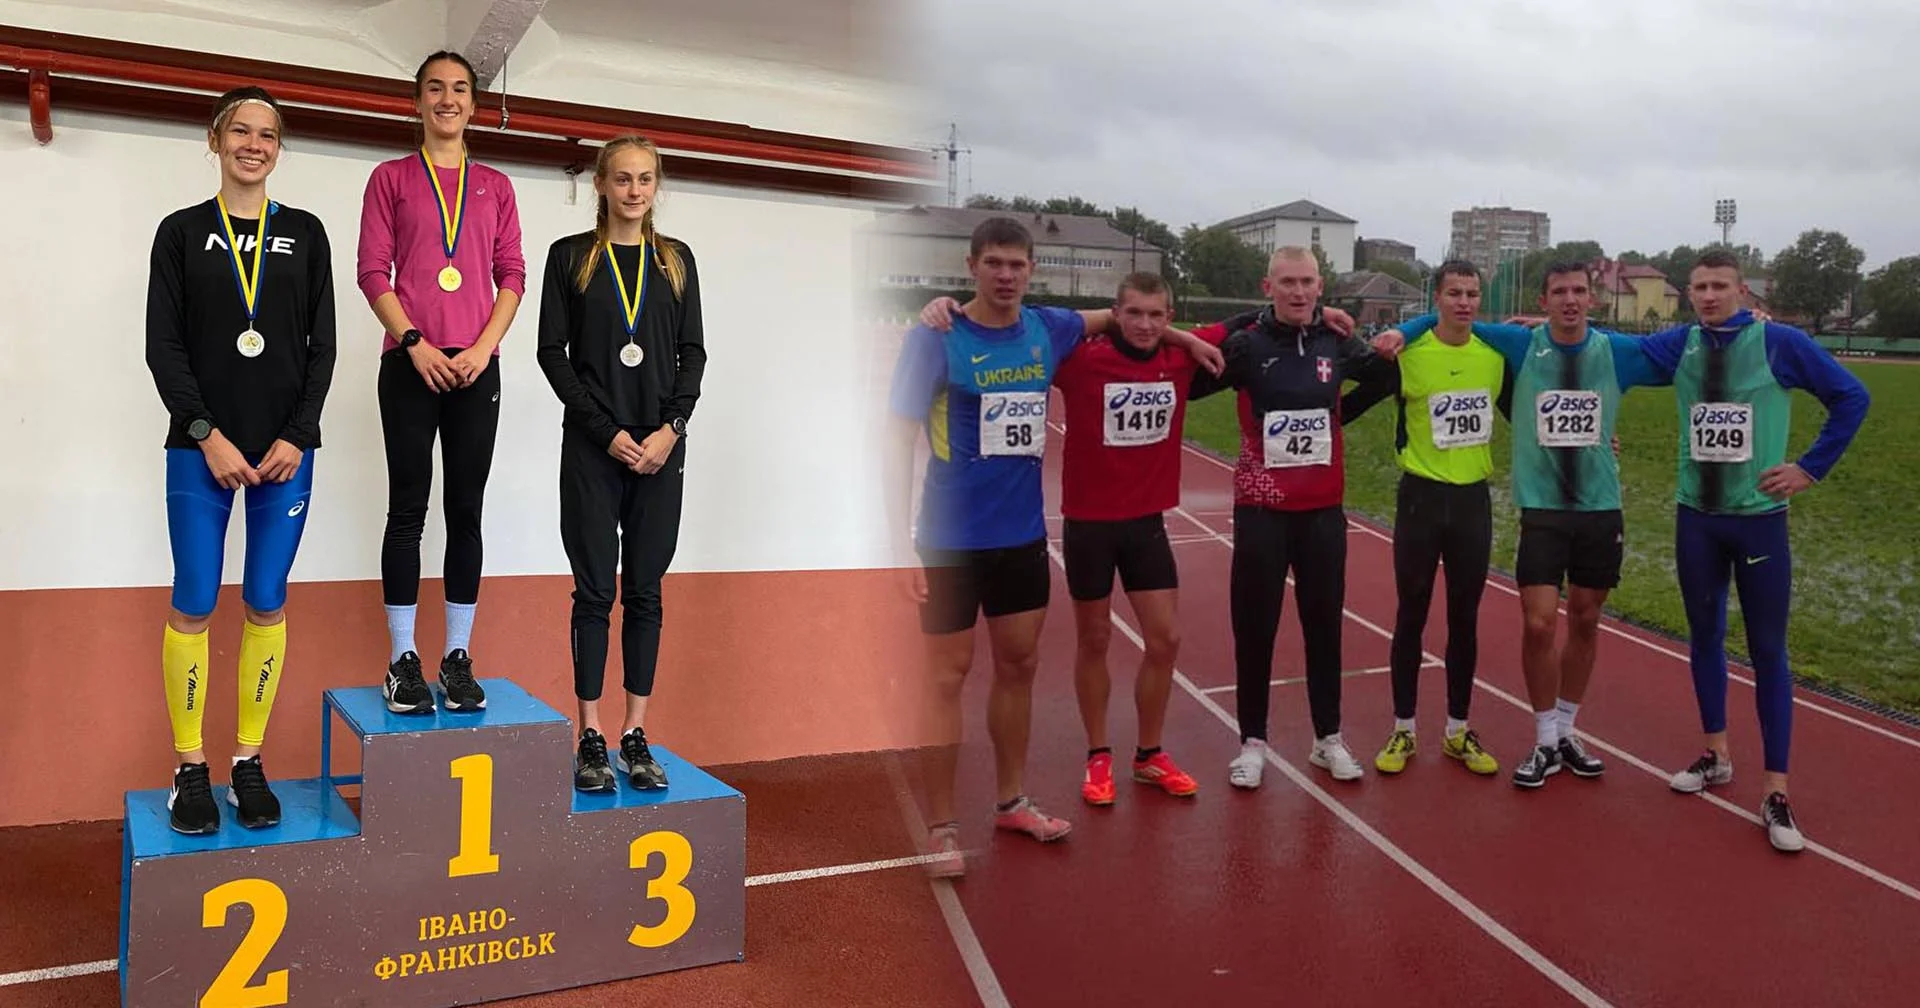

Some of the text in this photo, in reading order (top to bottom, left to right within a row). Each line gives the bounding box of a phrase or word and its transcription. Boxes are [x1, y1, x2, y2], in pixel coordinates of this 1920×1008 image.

[205, 233, 295, 255] NIKE
[975, 364, 1046, 387] UKRAINE
[1132, 390, 1172, 406] asics
[1452, 396, 1488, 411] asics
[1560, 397, 1598, 411] asics
[1114, 409, 1167, 431] 1416
[1289, 416, 1326, 432] asics
[1445, 414, 1481, 435] 790
[1544, 414, 1594, 433] 1282
[1706, 410, 1748, 424] asics
[1005, 424, 1032, 447] 58
[1286, 435, 1313, 455] 42
[1696, 428, 1744, 448] 1249
[449, 753, 499, 878] 1
[627, 830, 697, 948] 3
[418, 907, 516, 941] ІВАНО-
[200, 878, 289, 1008] 2
[374, 932, 556, 981] ФРАНКІВСЬК
